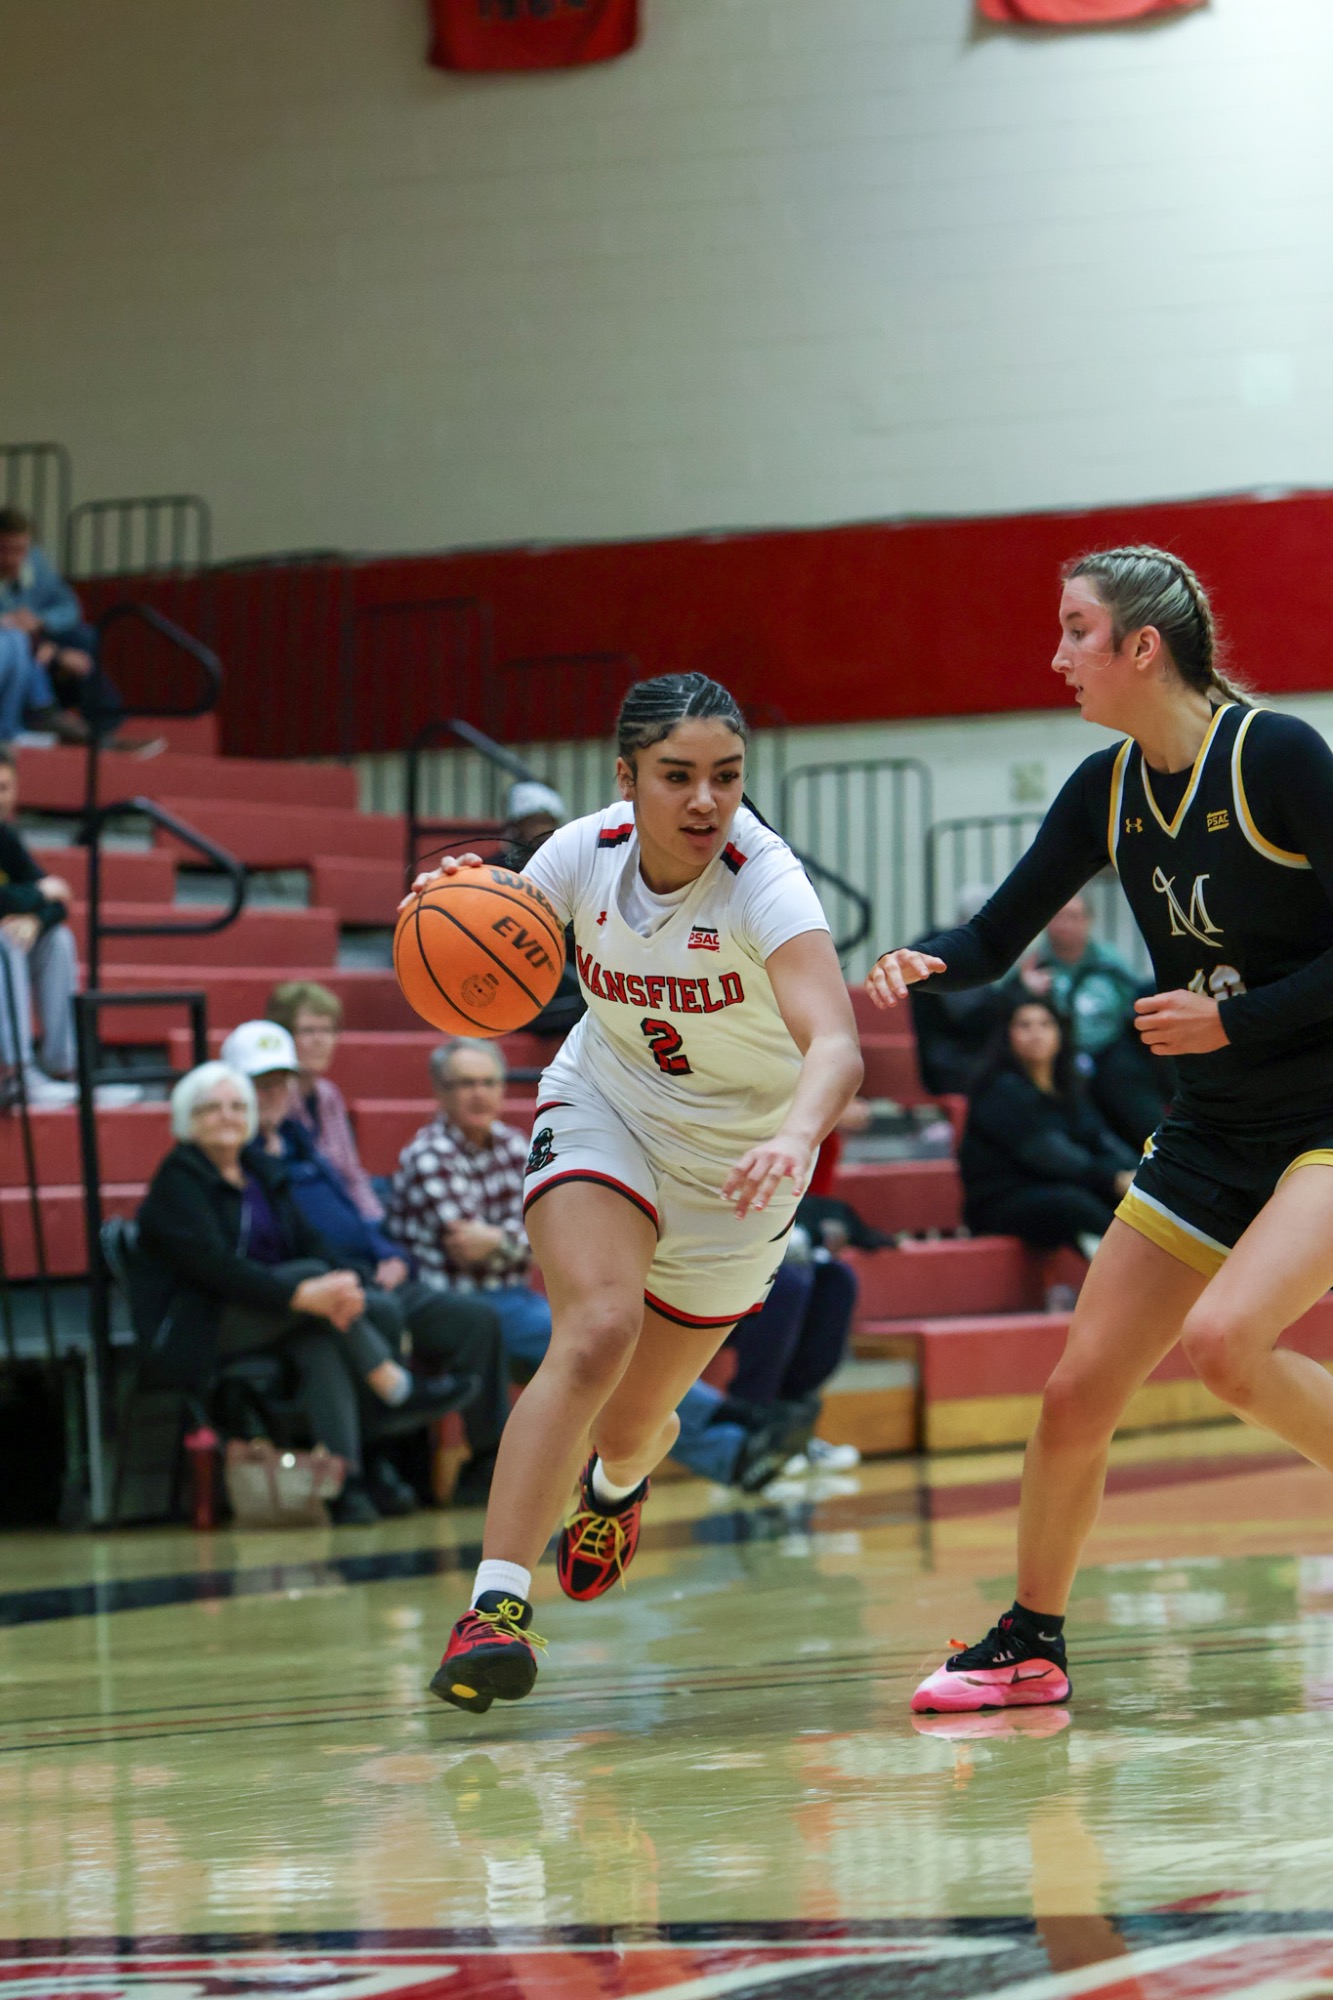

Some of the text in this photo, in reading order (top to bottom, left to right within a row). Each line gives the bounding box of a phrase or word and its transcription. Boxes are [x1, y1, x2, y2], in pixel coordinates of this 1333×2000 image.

[1207, 813, 1229, 827] PSAC
[1152, 866, 1224, 947] M
[491, 915, 550, 969] EVO
[688, 931, 720, 945] PSAC
[576, 945, 745, 1013] MANSFIELD
[640, 1017, 694, 1076] 2
